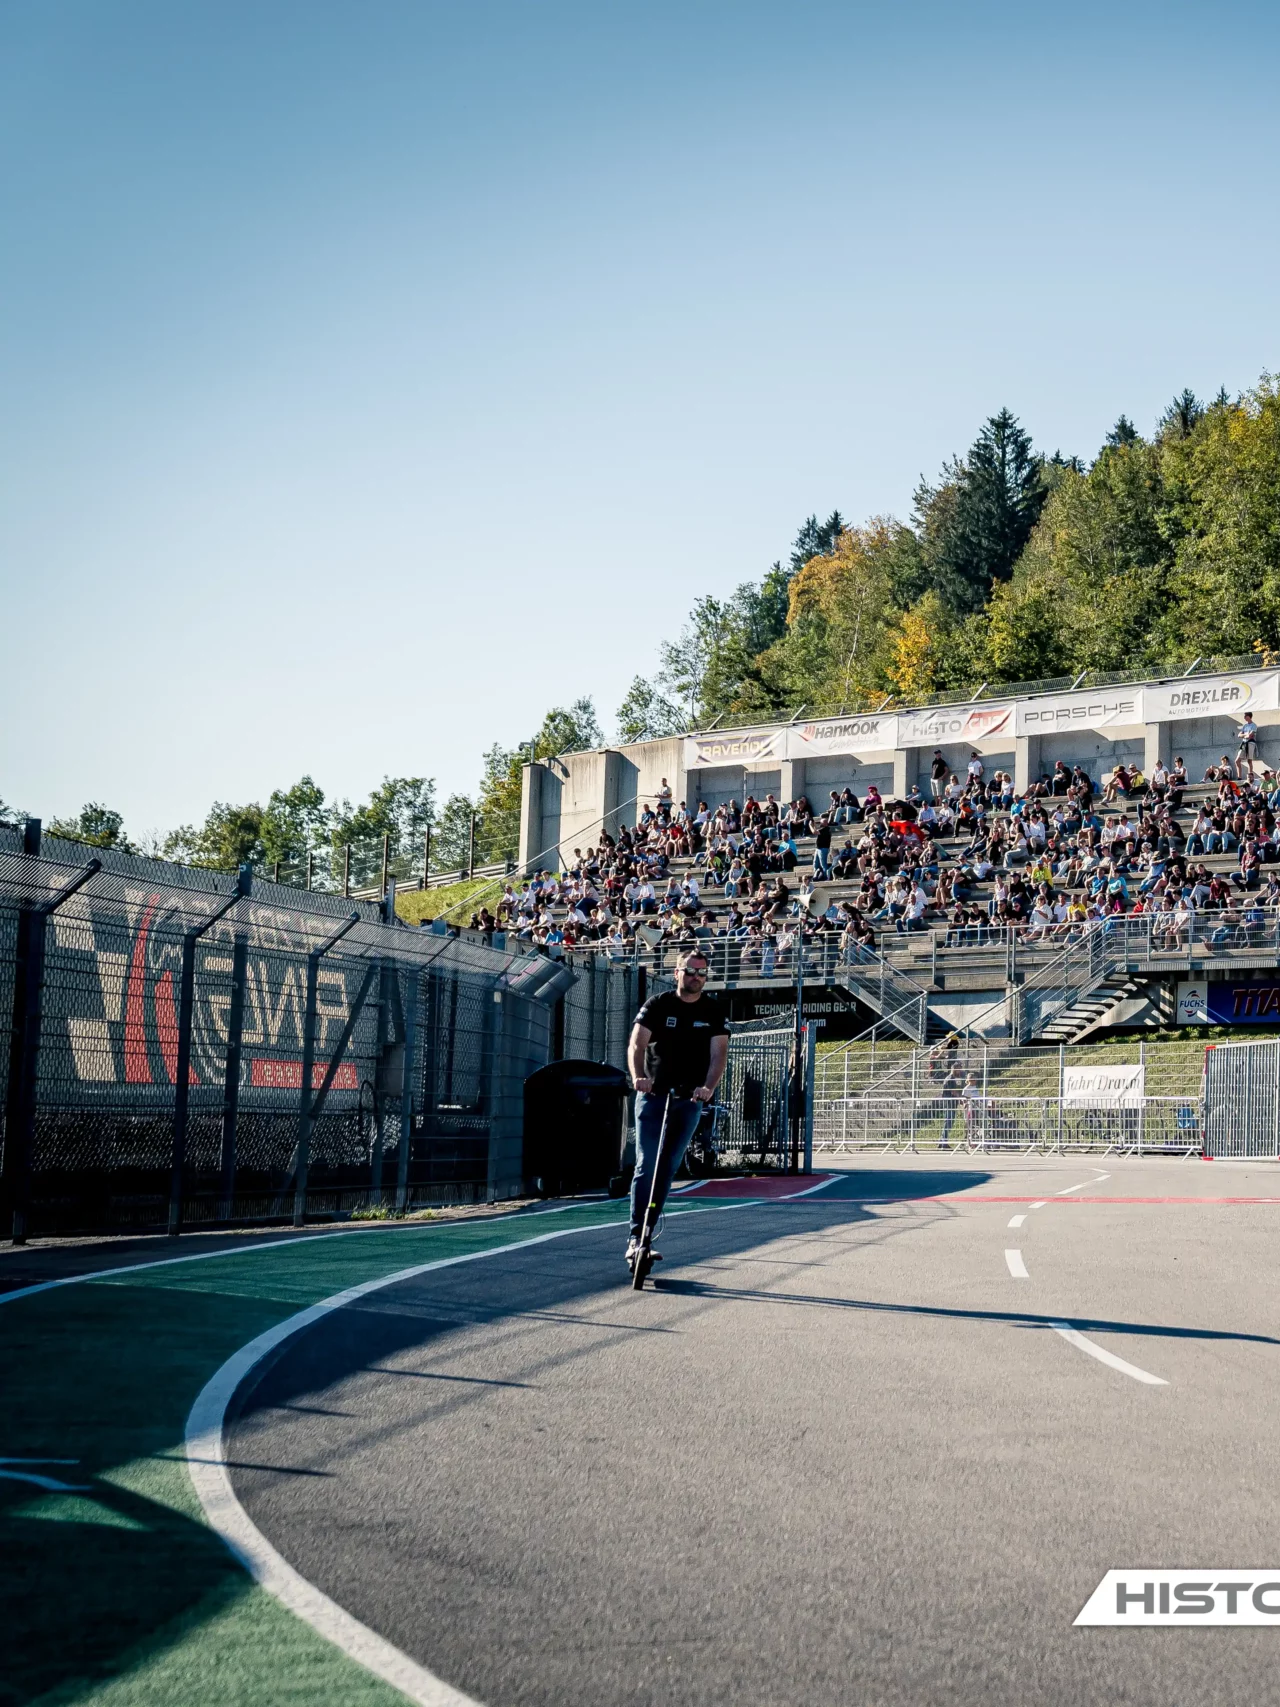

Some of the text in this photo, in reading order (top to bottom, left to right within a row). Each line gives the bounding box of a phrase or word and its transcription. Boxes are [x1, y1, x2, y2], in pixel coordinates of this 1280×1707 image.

[1024, 701, 1135, 724] PORSCHE
[912, 719, 962, 737] HISTO
[802, 1003, 831, 1013] RIDING
[1180, 999, 1204, 1008] FUCHS
